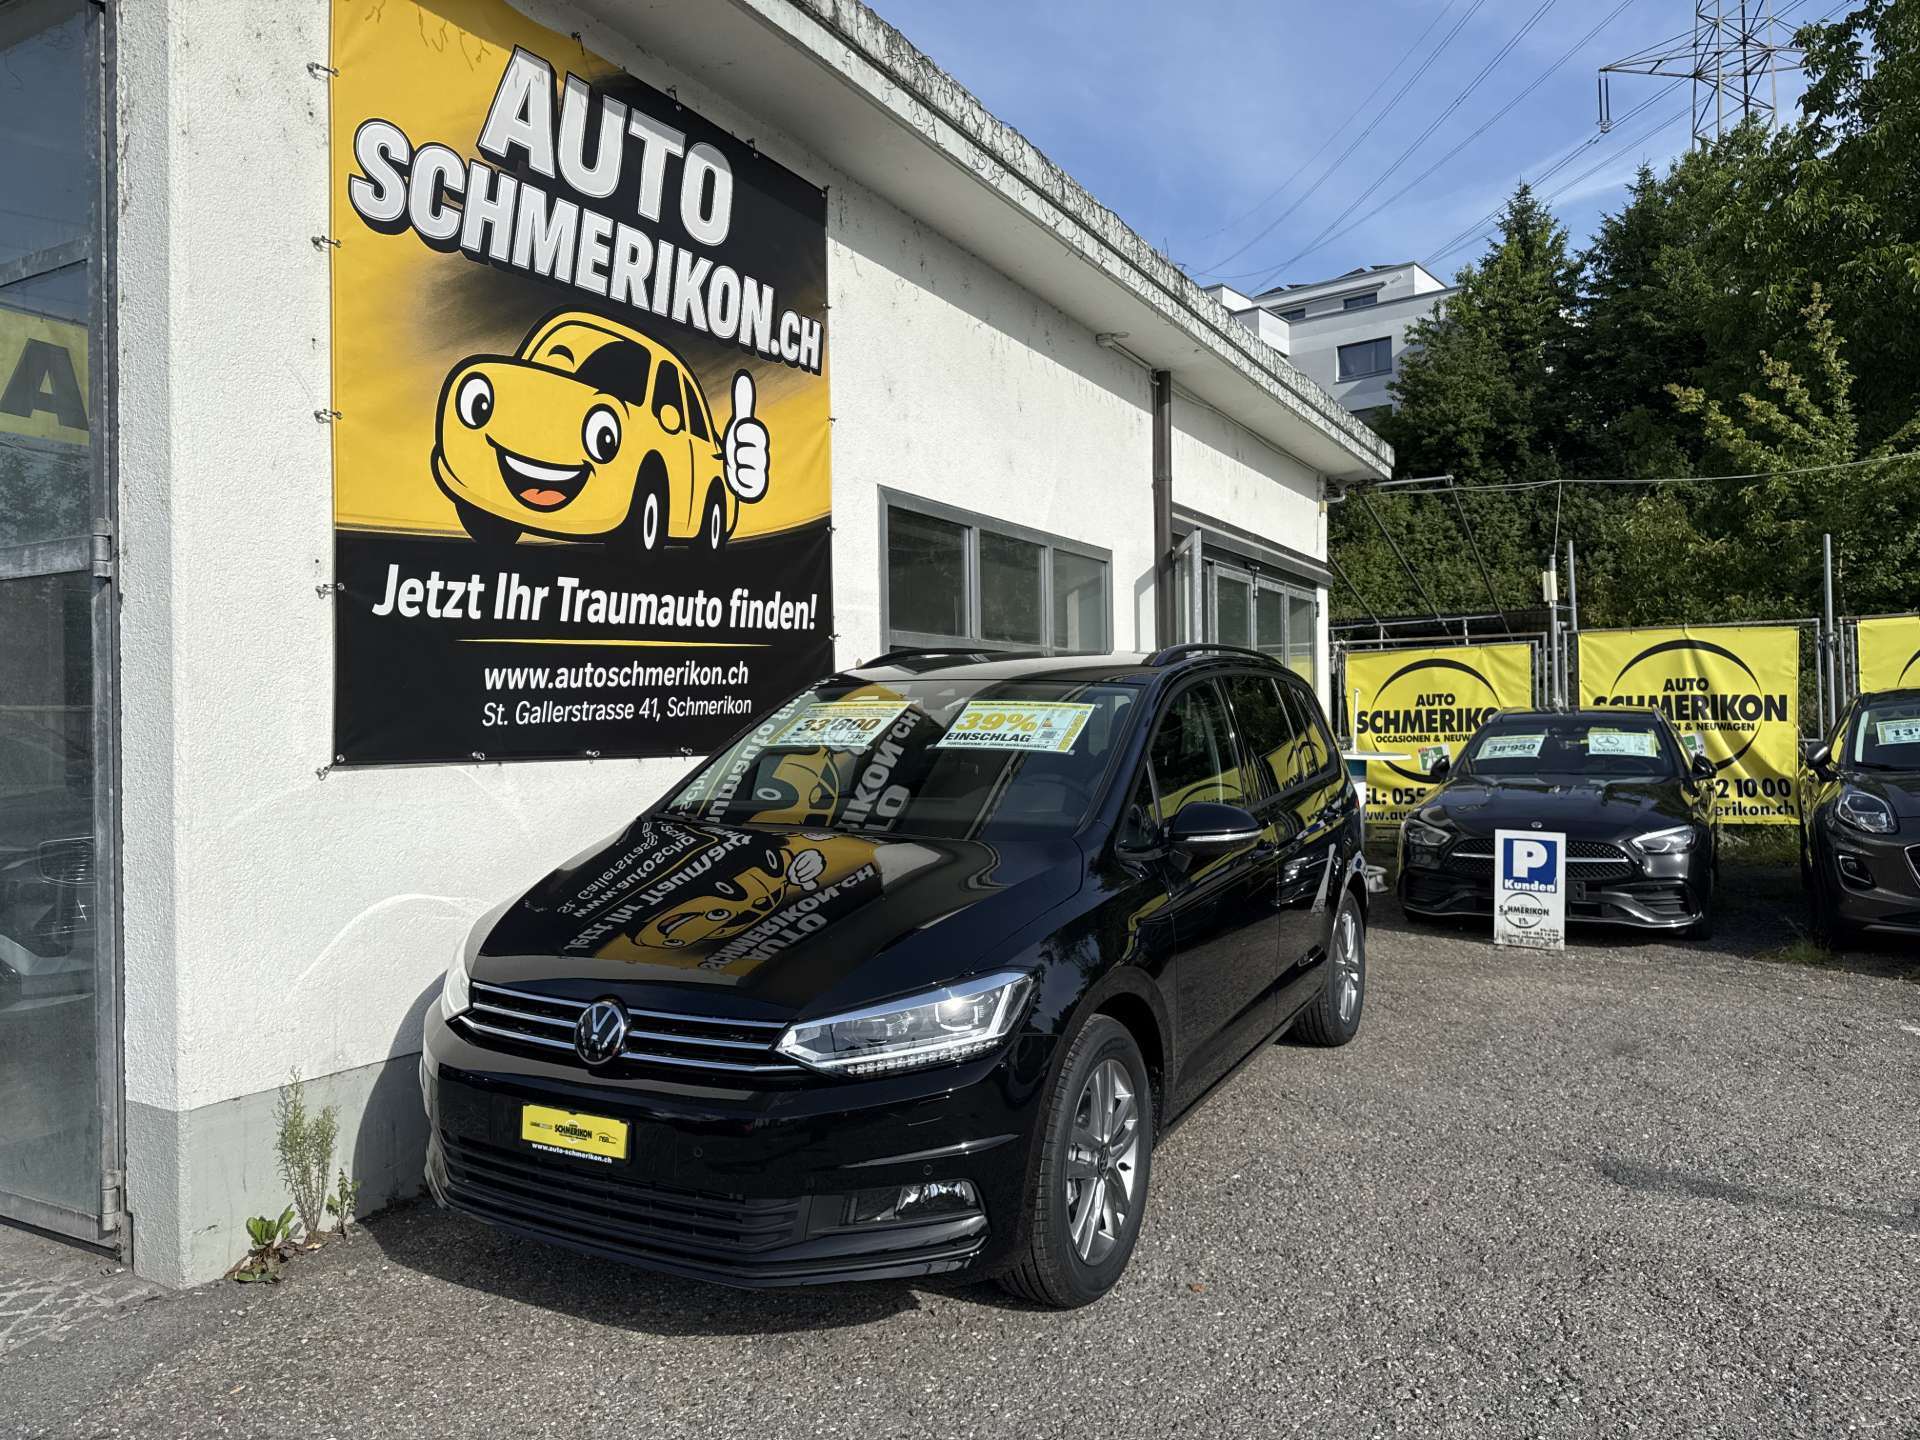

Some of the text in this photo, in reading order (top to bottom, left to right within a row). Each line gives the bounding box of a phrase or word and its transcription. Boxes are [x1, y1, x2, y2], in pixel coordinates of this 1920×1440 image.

[479, 45, 733, 246] AUTO
[349, 119, 823, 373] SCHMERIKON.CH
[371, 563, 817, 630] Jetzt Ihr Traumauto finden!
[484, 660, 749, 691] www.autoschmerikon.ch
[1663, 677, 1709, 692] AUTO
[1415, 693, 1456, 707] AUTO
[482, 701, 508, 727] St.
[515, 698, 634, 724] Gallerstrasse
[638, 697, 662, 723] 41,
[667, 695, 752, 717] Schmerikon
[955, 711, 1039, 732] 39%
[1696, 722, 1755, 731] NEUWAGEN
[945, 732, 1033, 743] EINSCHLAG
[1375, 735, 1431, 743] OCCASIONEN
[1735, 778, 1758, 798] 10
[1761, 778, 1791, 798] 00
[1512, 840, 1548, 879] P
[1504, 879, 1556, 893] Kunden
[554, 1124, 593, 1140] SCHMERIKON
[531, 1142, 613, 1164] www.auto-schmerikon.ch
